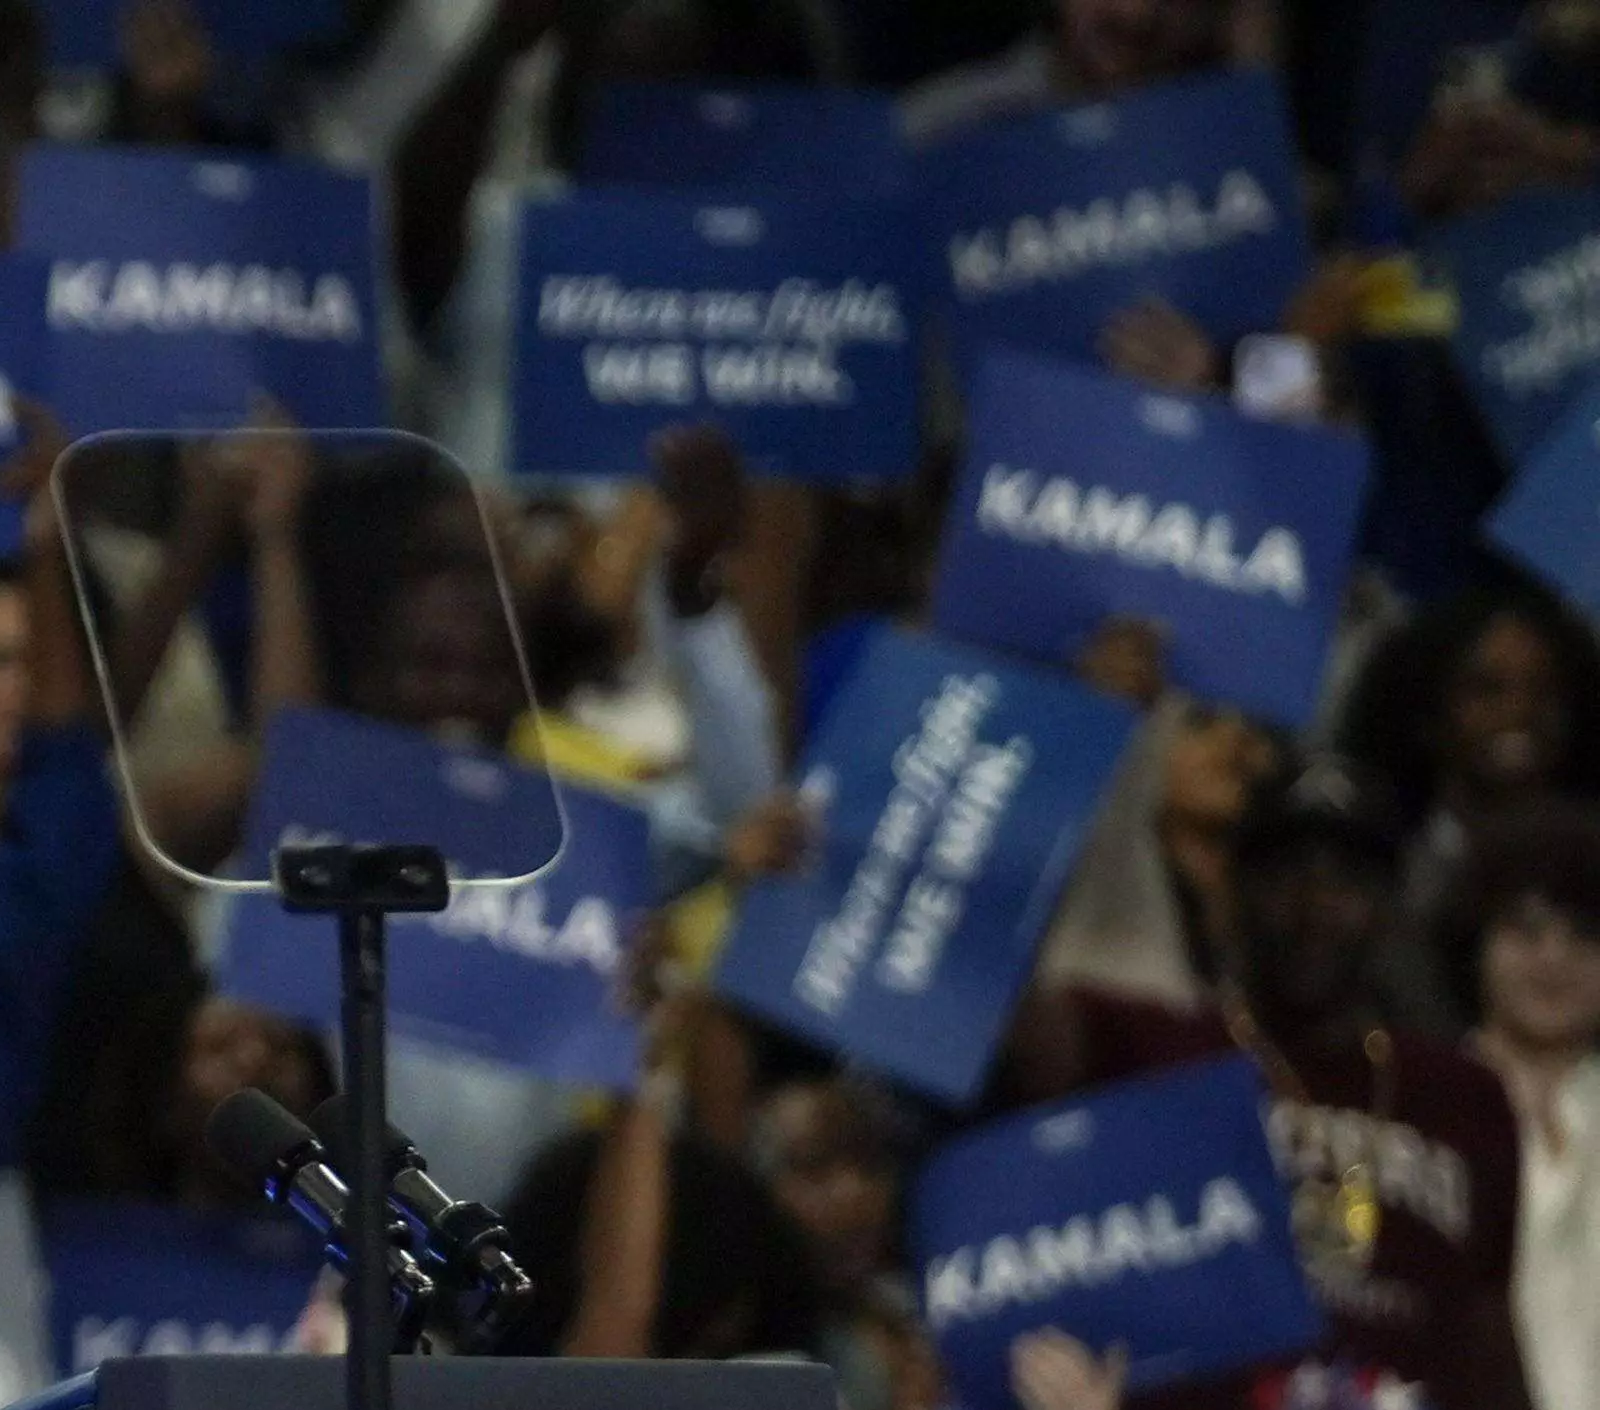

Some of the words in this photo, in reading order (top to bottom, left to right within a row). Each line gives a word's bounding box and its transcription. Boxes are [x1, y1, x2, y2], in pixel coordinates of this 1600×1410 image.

[46, 259, 360, 343] KAMALA
[974, 462, 1306, 600] KAMALA
[925, 1176, 1260, 1326] KAMALA
